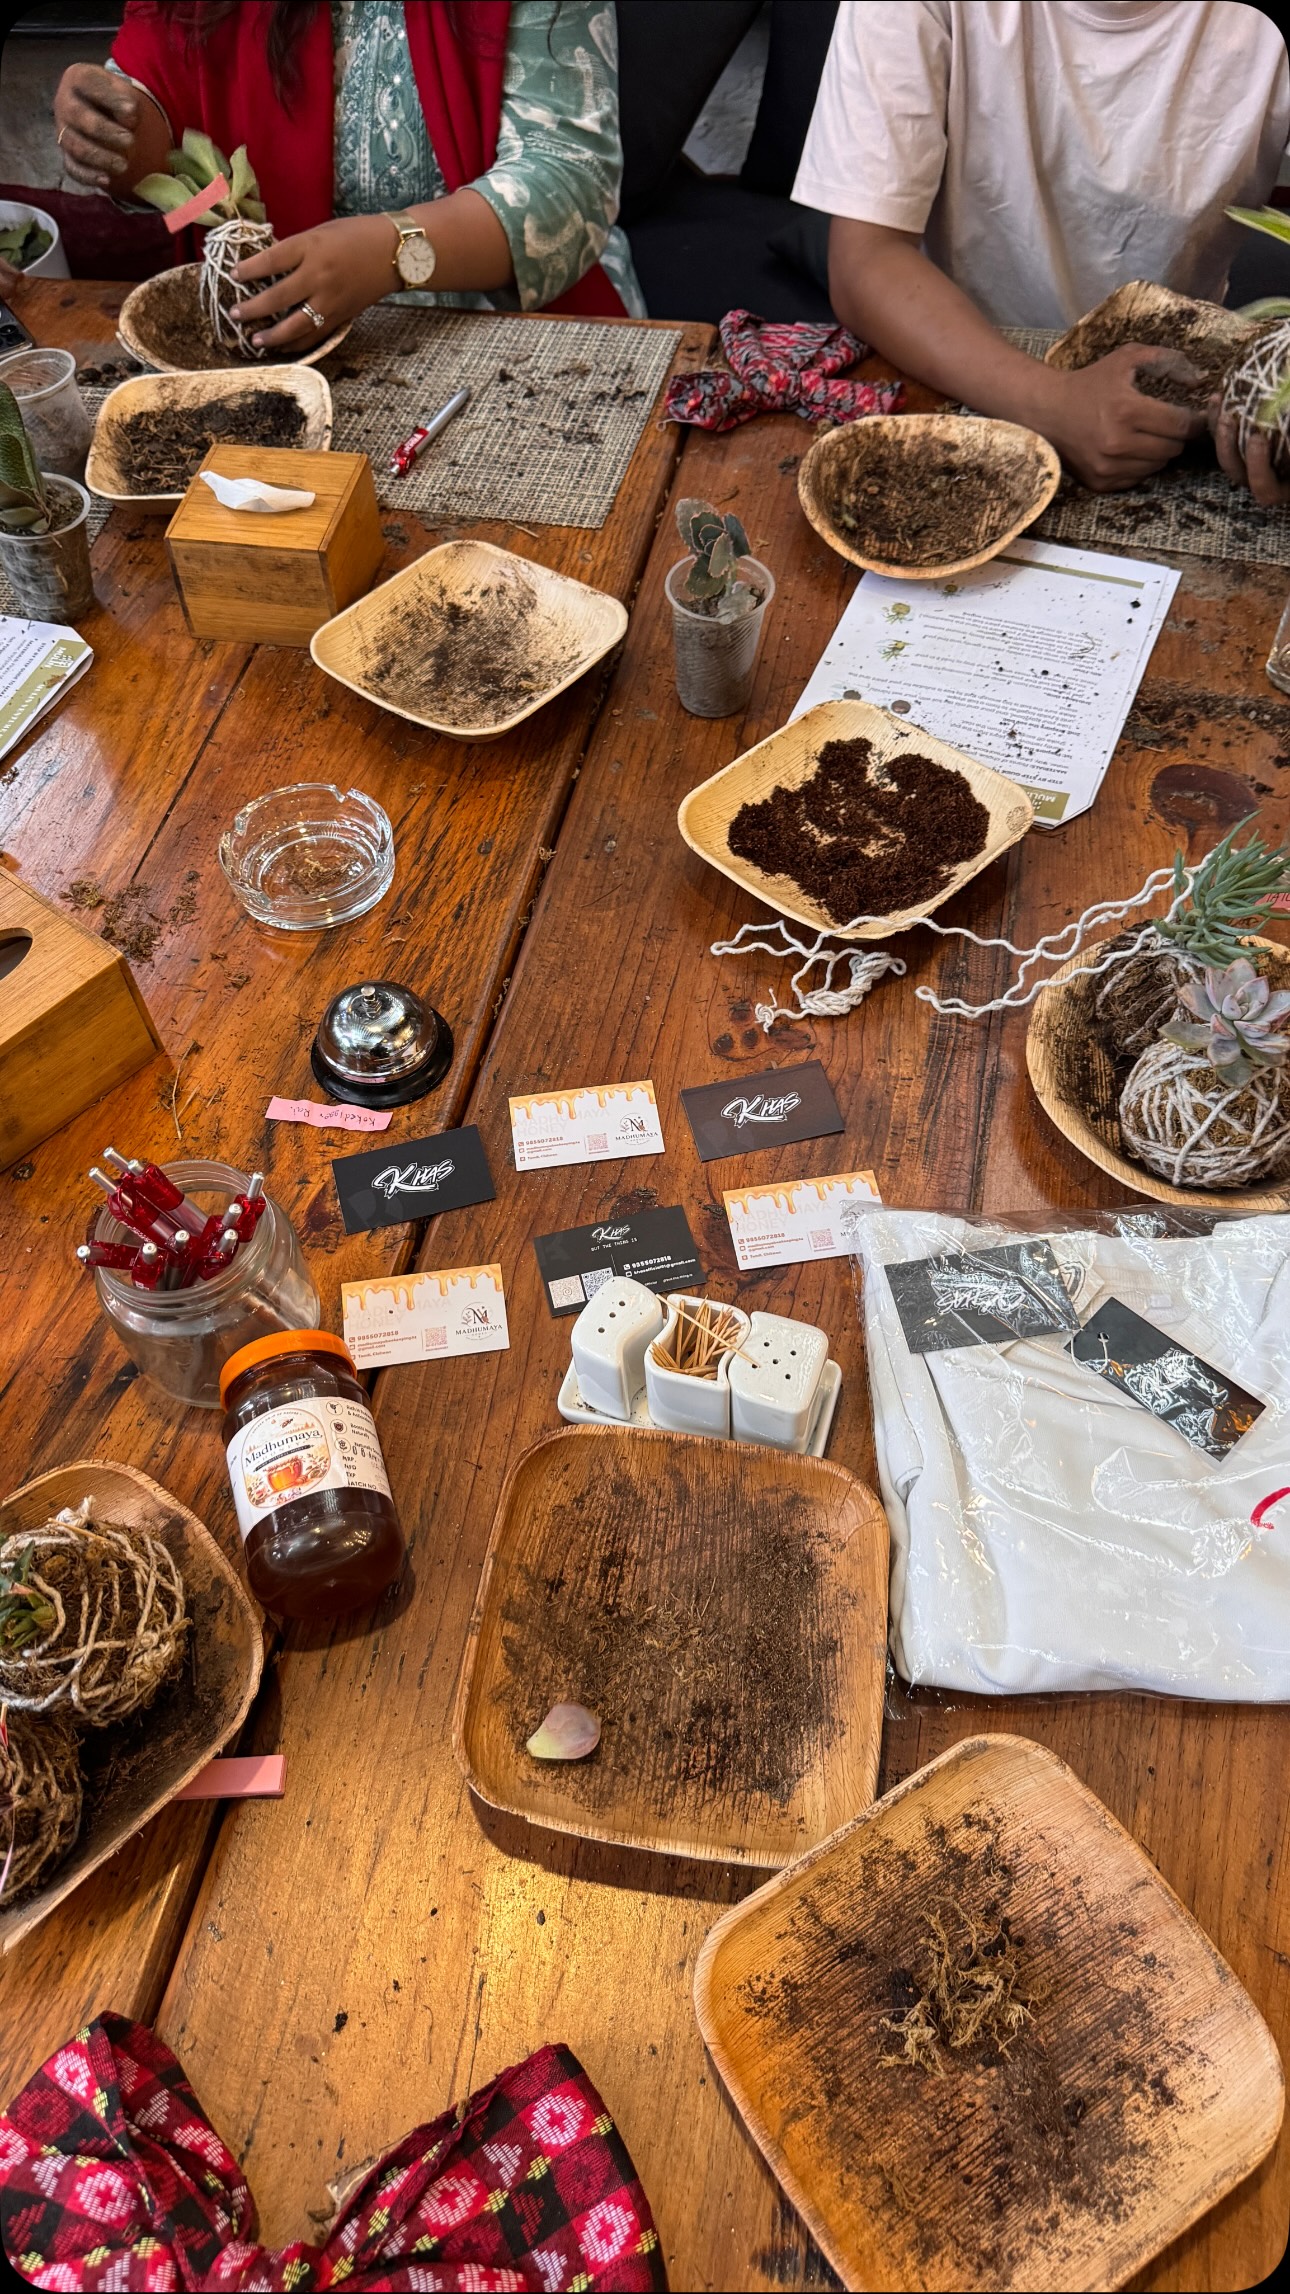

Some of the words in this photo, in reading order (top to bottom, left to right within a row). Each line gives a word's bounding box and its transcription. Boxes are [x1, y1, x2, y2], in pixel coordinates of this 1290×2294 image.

[45, 646, 67, 668] MULIN
[1027, 791, 1056, 802] MULI
[720, 1091, 802, 1129] KHAS
[615, 1131, 658, 1141] MADHUMAYA
[371, 1158, 455, 1200] KHAS
[591, 1222, 632, 1242] KHAS
[455, 1323, 502, 1335] MADHUMAYA
[245, 1430, 323, 1467] Madhumaya
